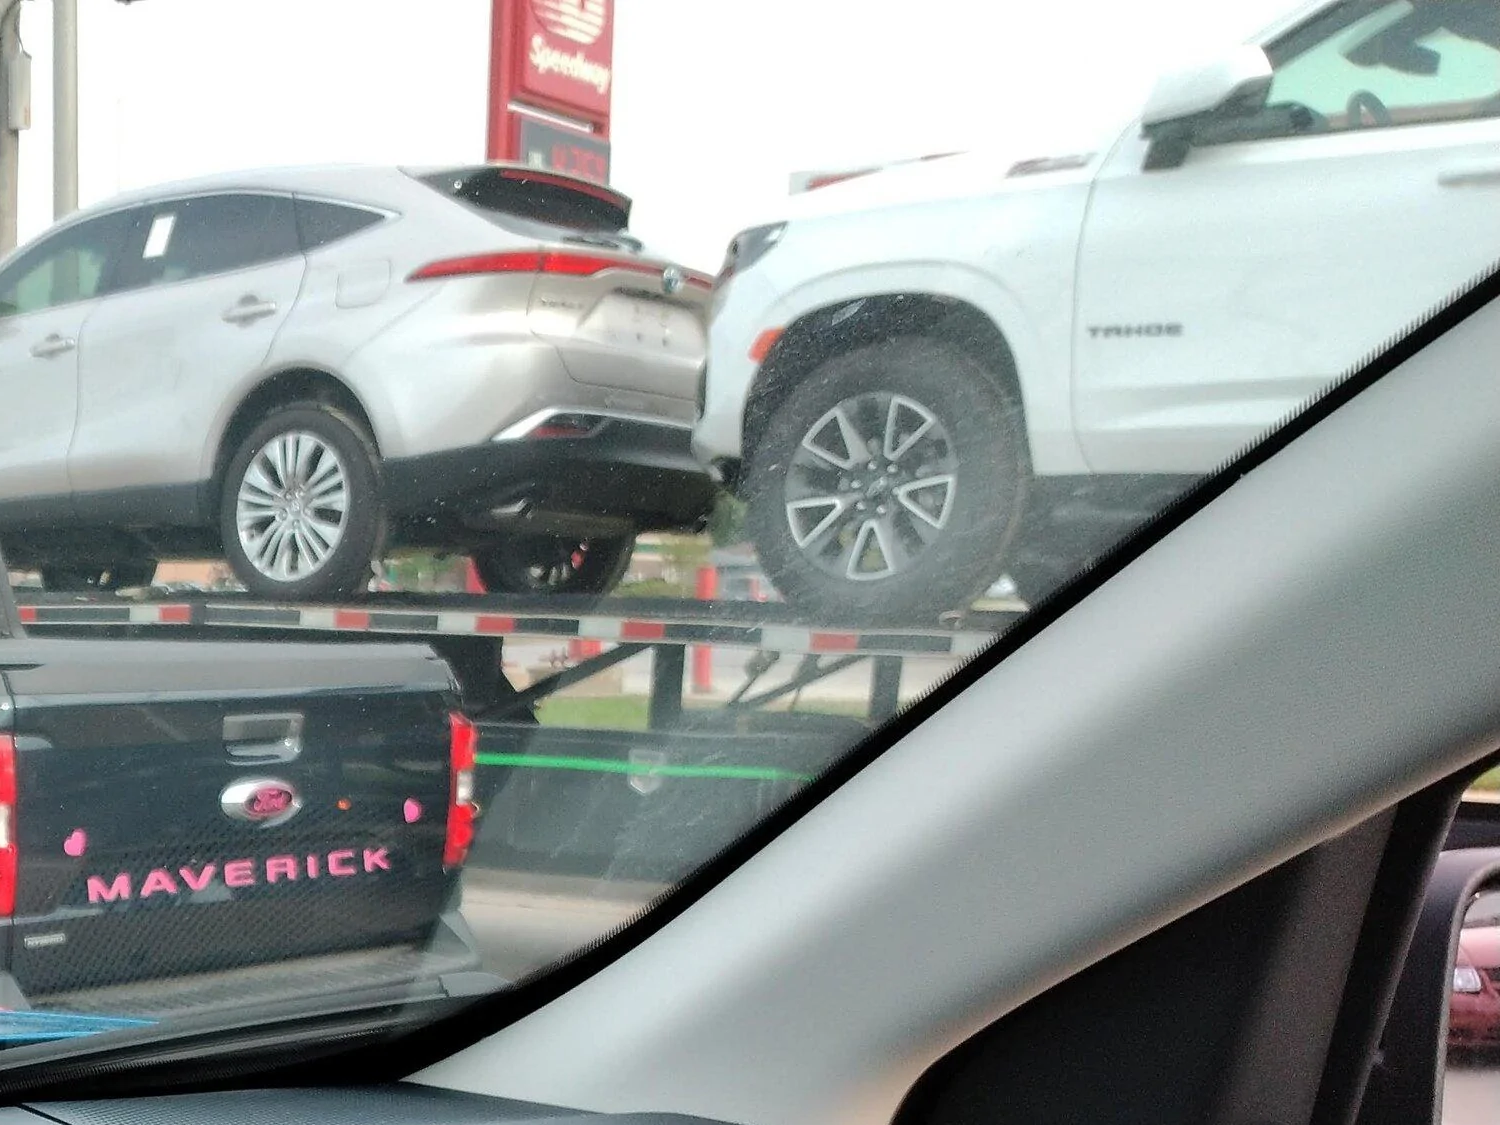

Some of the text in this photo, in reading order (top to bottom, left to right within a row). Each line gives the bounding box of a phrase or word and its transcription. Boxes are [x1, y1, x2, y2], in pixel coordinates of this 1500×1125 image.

[529, 33, 611, 95] Speedway
[1086, 322, 1185, 338] TAHOE
[86, 847, 391, 904] MAVERICK
